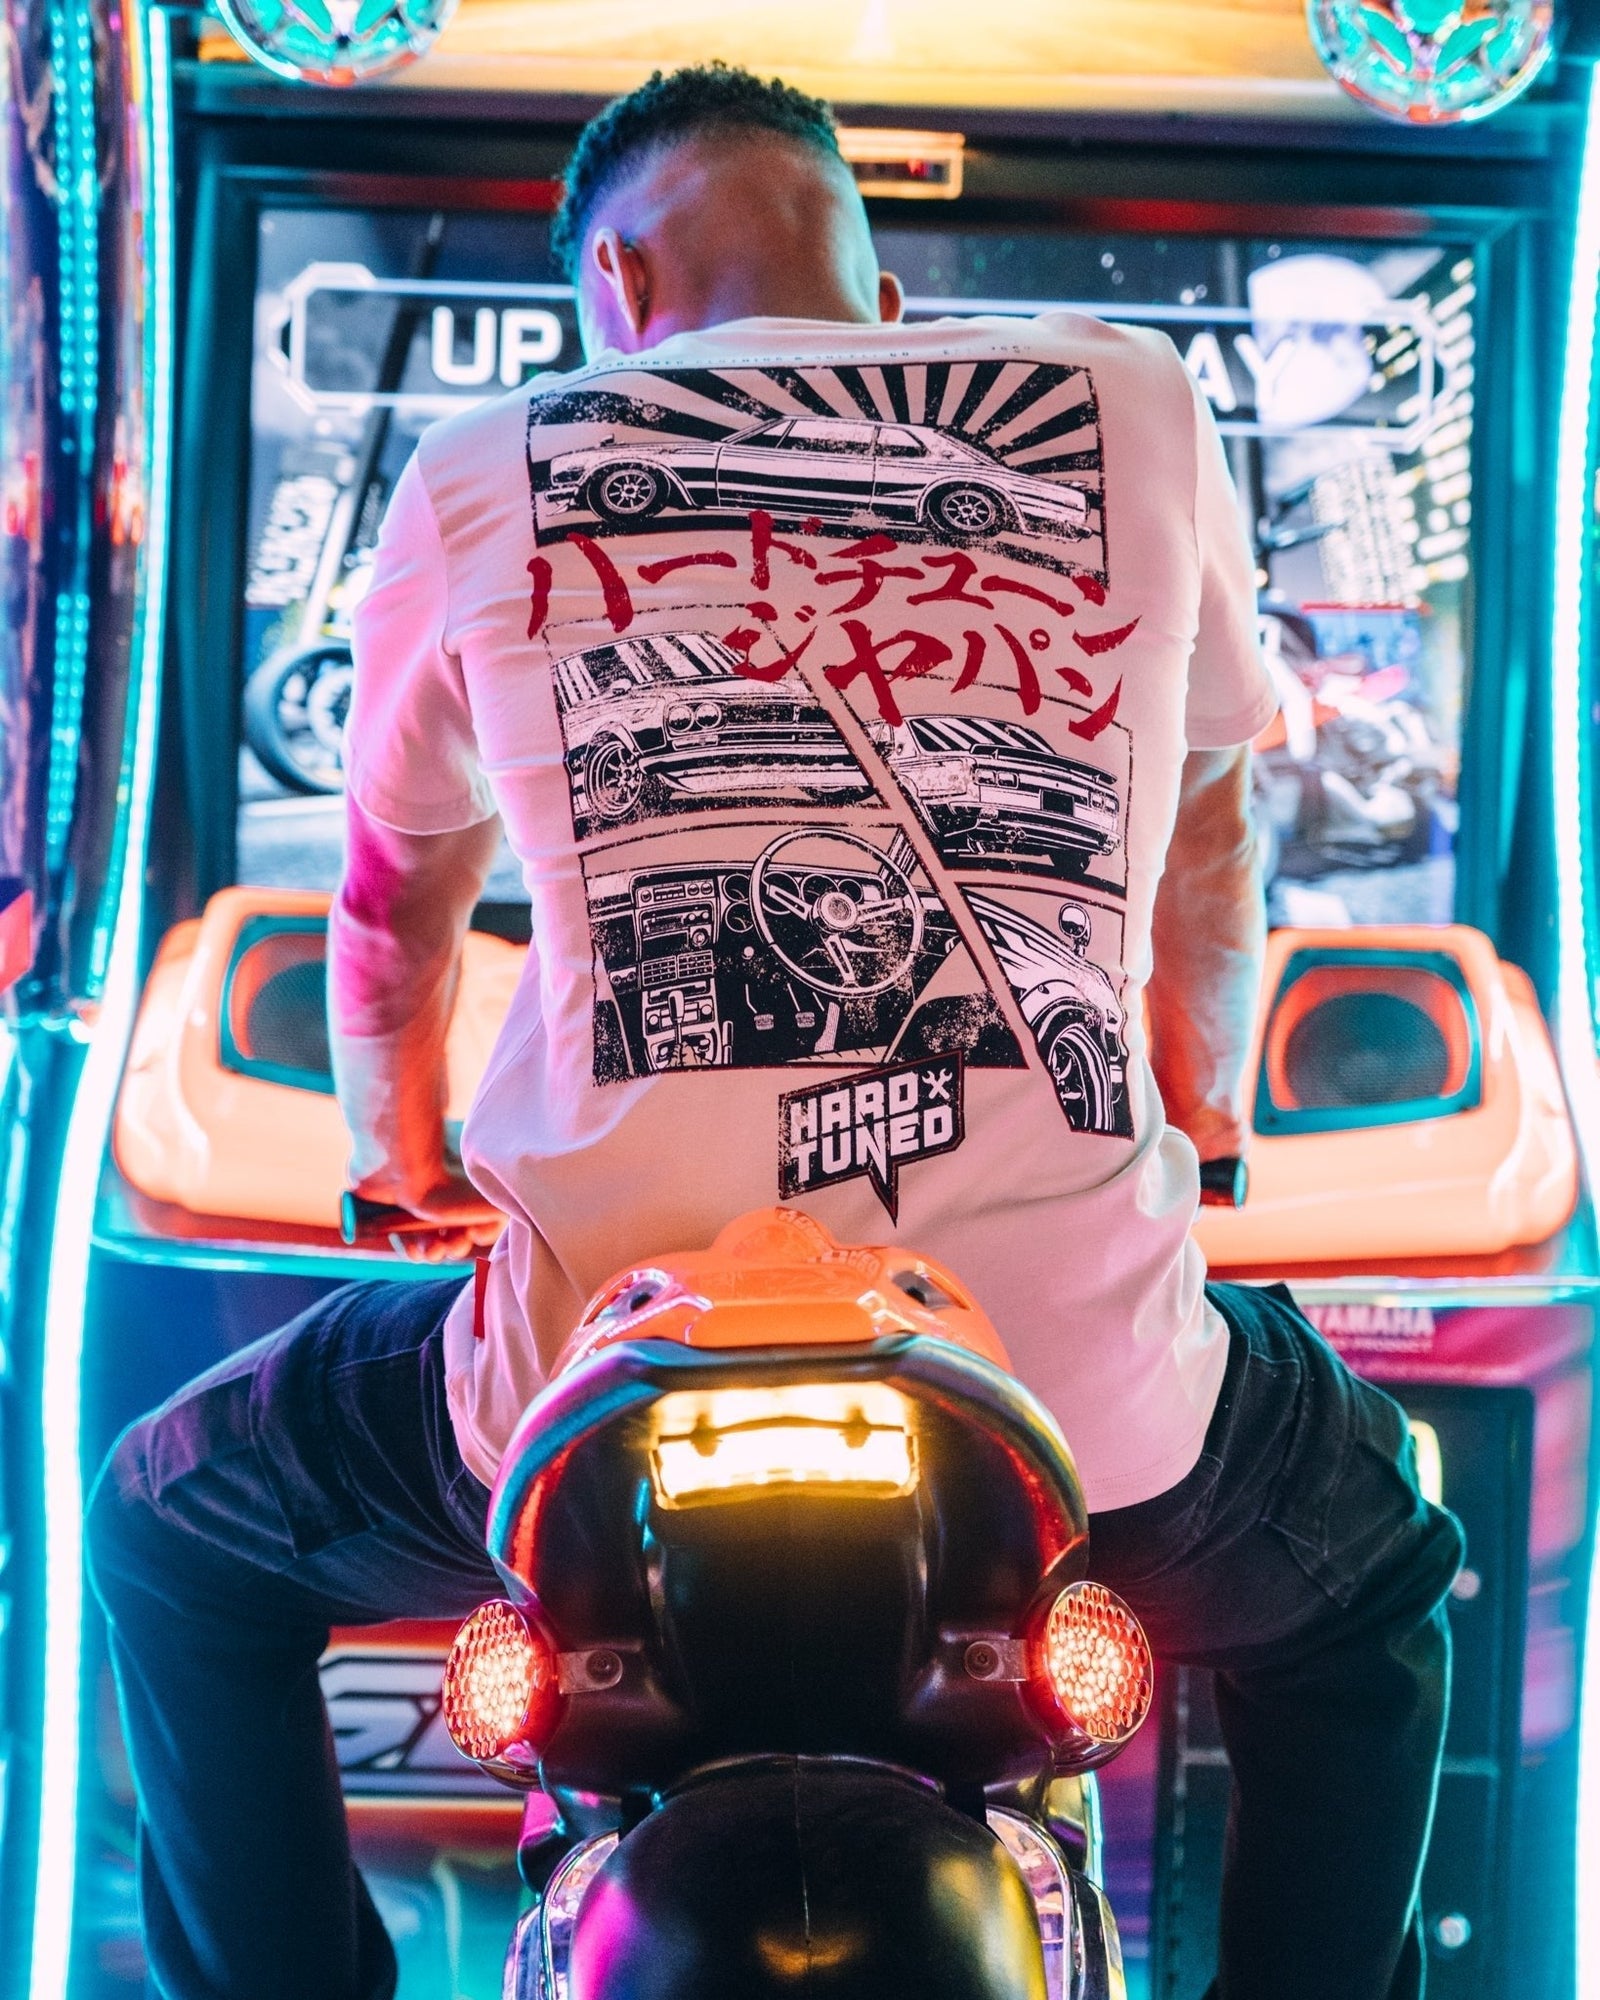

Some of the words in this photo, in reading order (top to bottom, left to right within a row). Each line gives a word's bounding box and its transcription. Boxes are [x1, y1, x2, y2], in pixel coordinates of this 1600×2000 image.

[432, 306, 562, 387] UP
[1183, 332, 1300, 412] AY
[790, 1071, 919, 1146] HARD
[790, 1104, 953, 1184] TUNED
